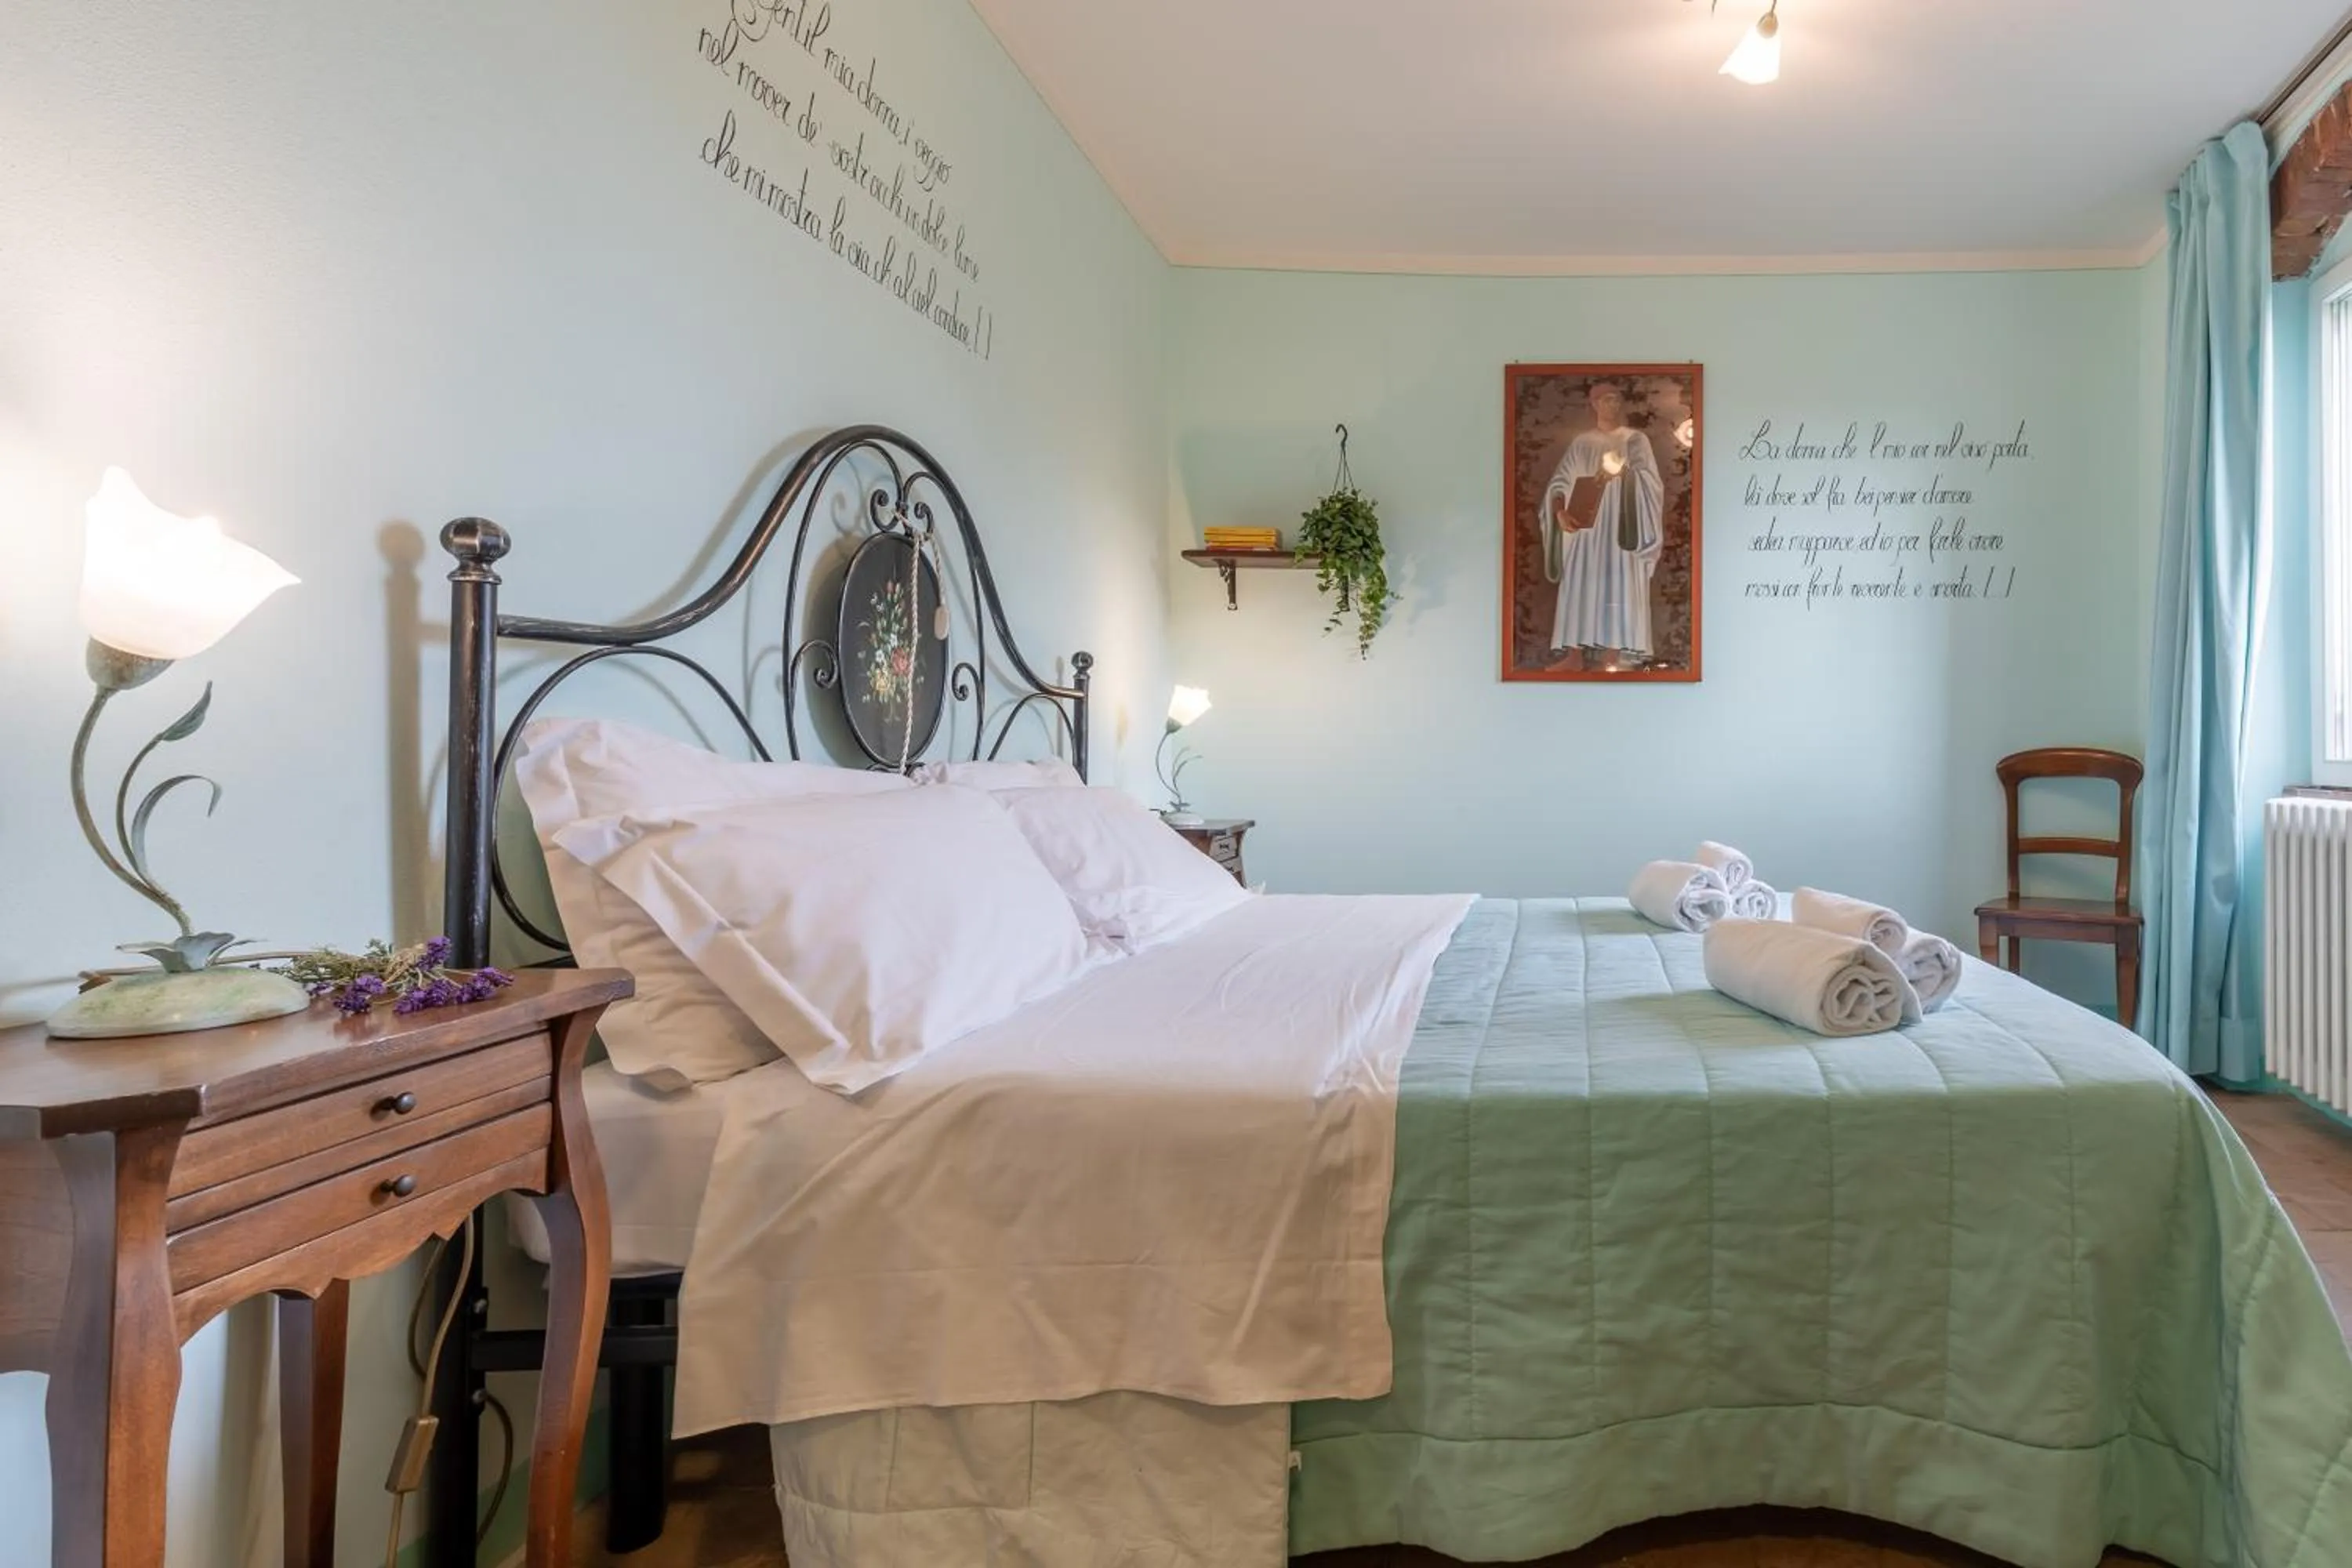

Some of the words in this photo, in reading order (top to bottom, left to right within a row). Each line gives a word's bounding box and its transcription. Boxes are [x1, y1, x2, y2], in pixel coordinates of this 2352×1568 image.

[698, 20, 739, 77] nel
[824, 47, 855, 93] mia
[699, 109, 740, 183] che
[829, 194, 845, 257] la
[1739, 419, 1780, 461] La
